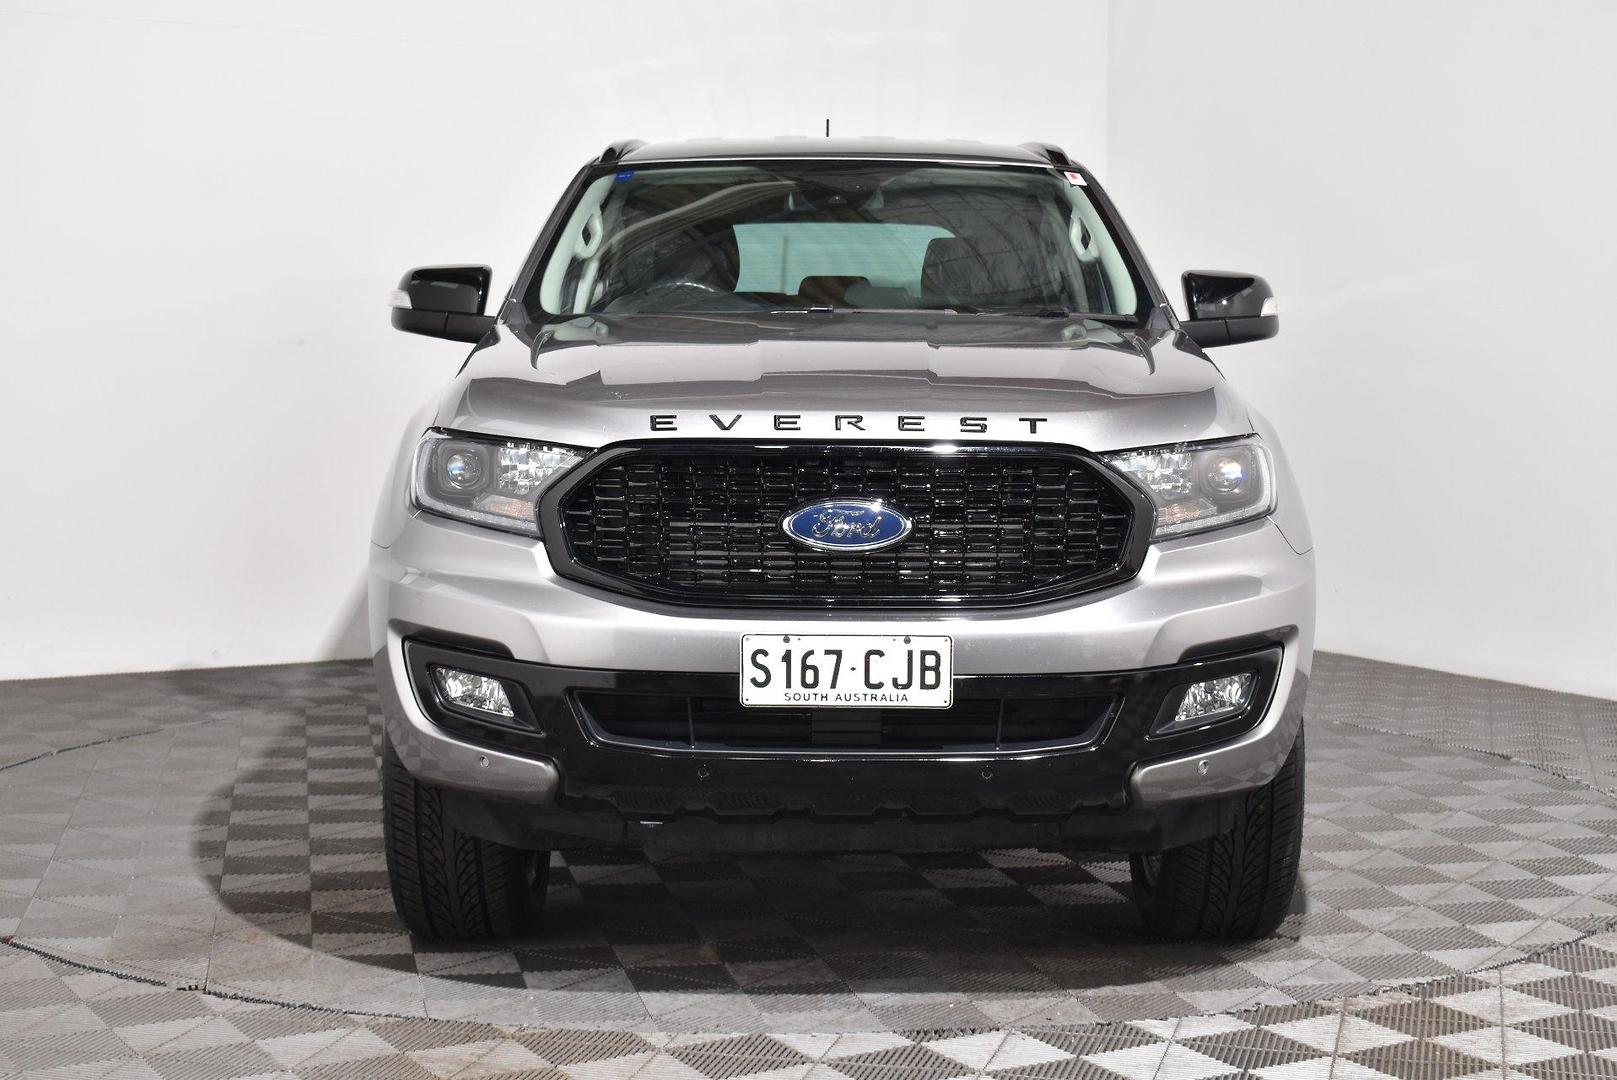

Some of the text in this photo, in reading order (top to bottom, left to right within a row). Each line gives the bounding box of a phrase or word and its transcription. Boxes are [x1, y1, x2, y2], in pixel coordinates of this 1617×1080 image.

[650, 414, 1048, 435] EVEREST
[812, 509, 881, 539] Ford
[784, 692, 909, 703] SOUTH AUSTRALIA
